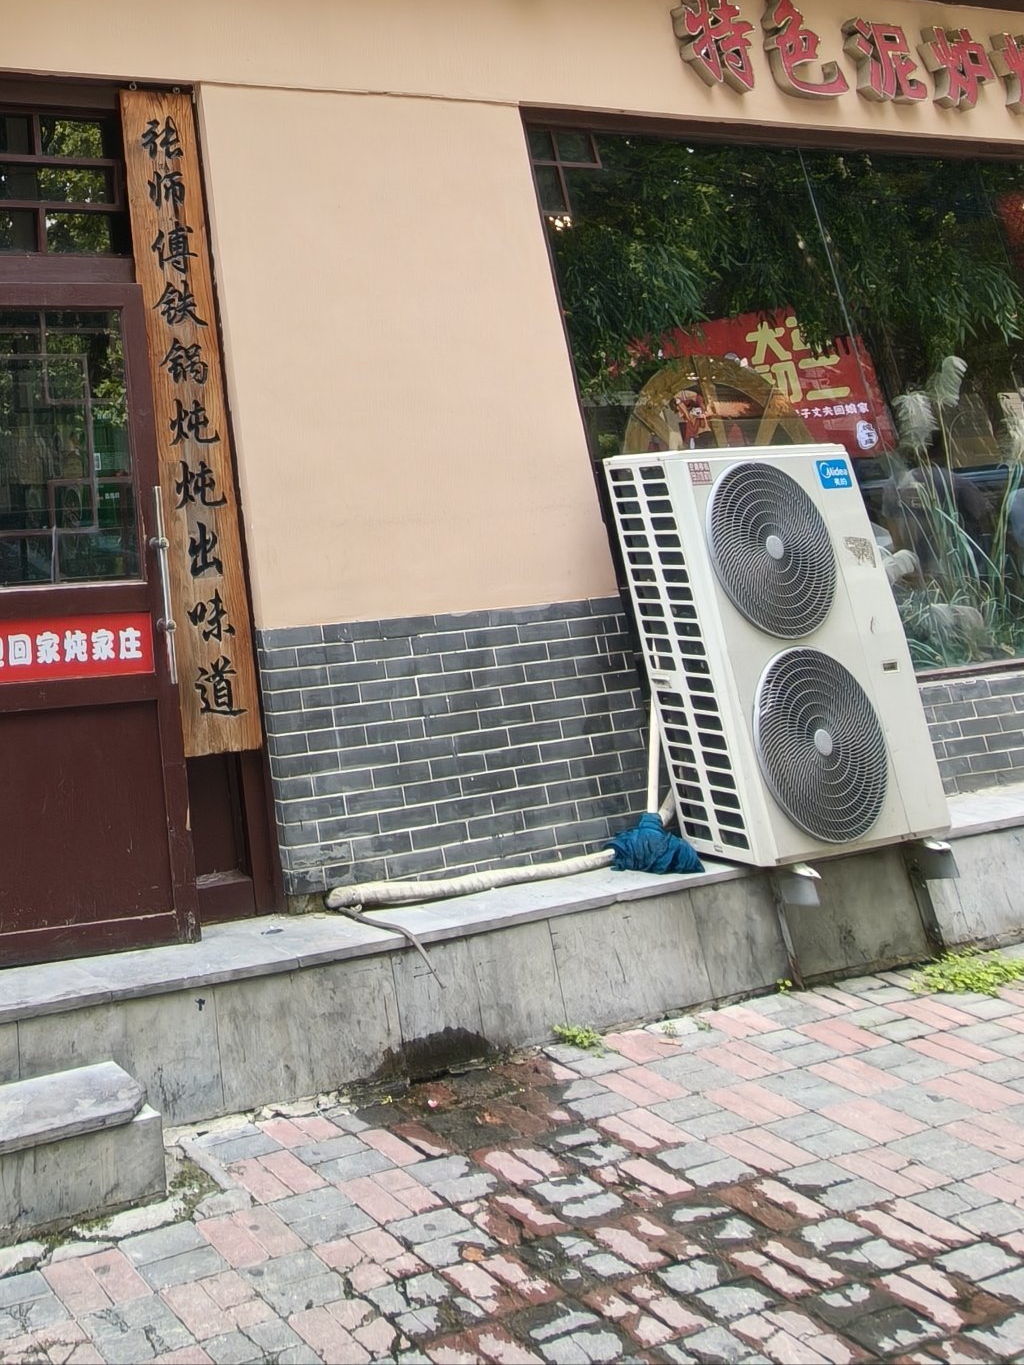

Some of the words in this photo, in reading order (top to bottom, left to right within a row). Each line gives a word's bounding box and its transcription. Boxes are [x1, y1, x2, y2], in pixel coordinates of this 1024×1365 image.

[141, 115, 248, 717] 张师傅铁锅炖炖出味道
[795, 402, 870, 419] 子丈夫回娘家
